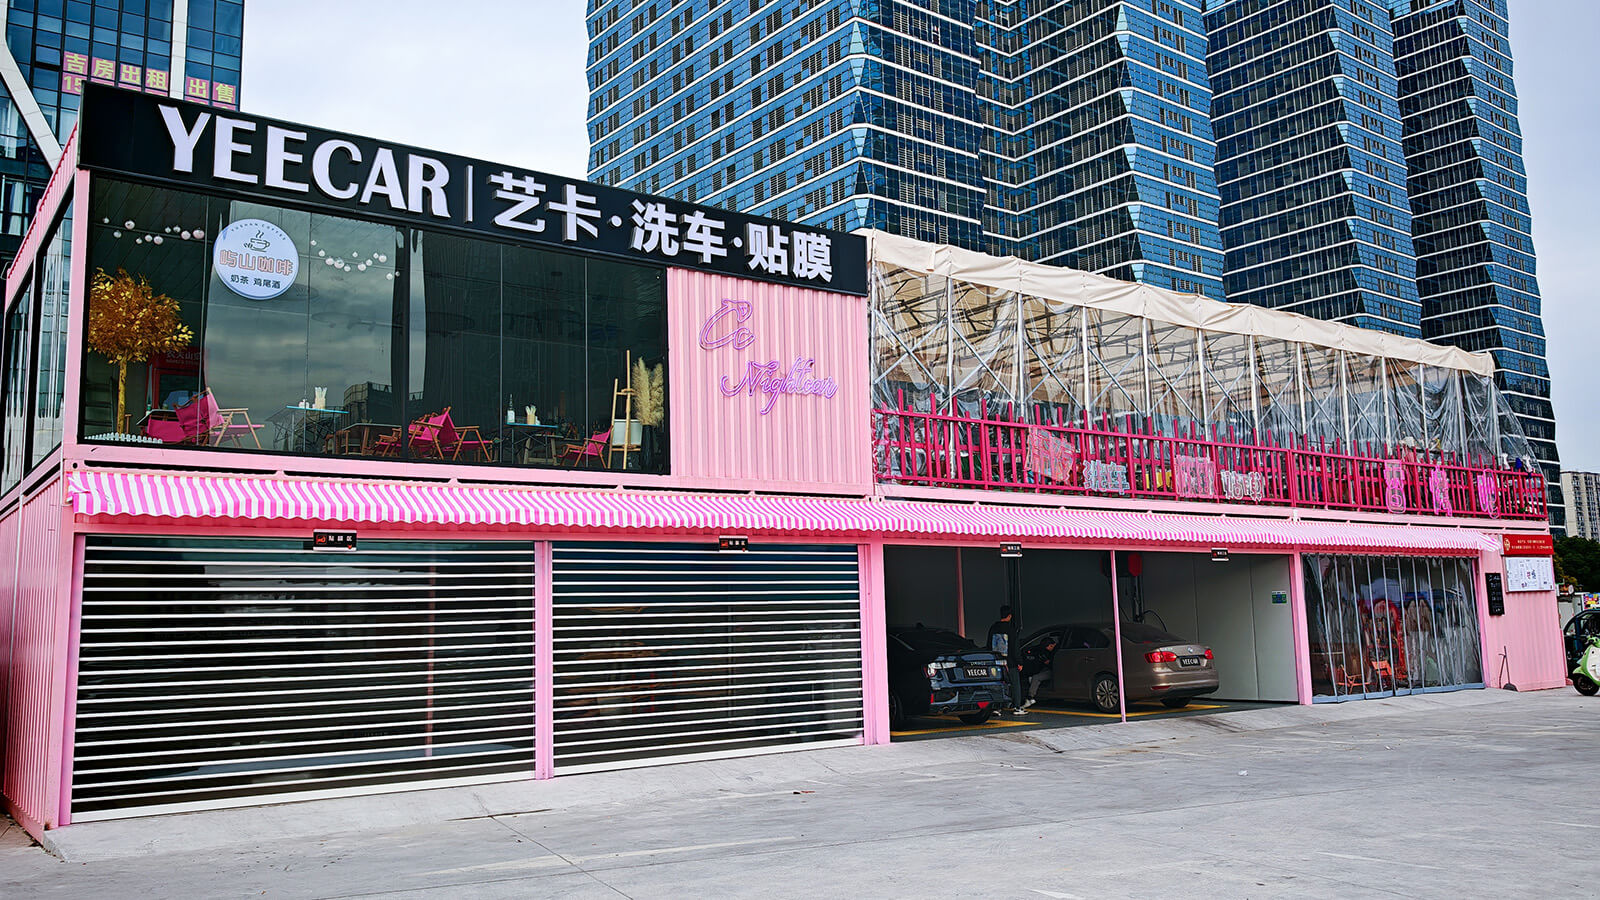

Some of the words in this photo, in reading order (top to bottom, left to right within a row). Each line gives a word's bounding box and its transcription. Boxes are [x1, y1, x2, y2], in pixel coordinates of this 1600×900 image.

[65, 53, 169, 91] 吉房出租
[188, 78, 235, 104] 出售
[157, 103, 451, 218] YEECAR
[219, 249, 294, 276] 屿山咖啡
[230, 274, 249, 285] 奶茶
[253, 277, 281, 289] 鸡尾酒
[966, 668, 988, 677] YEECAR
